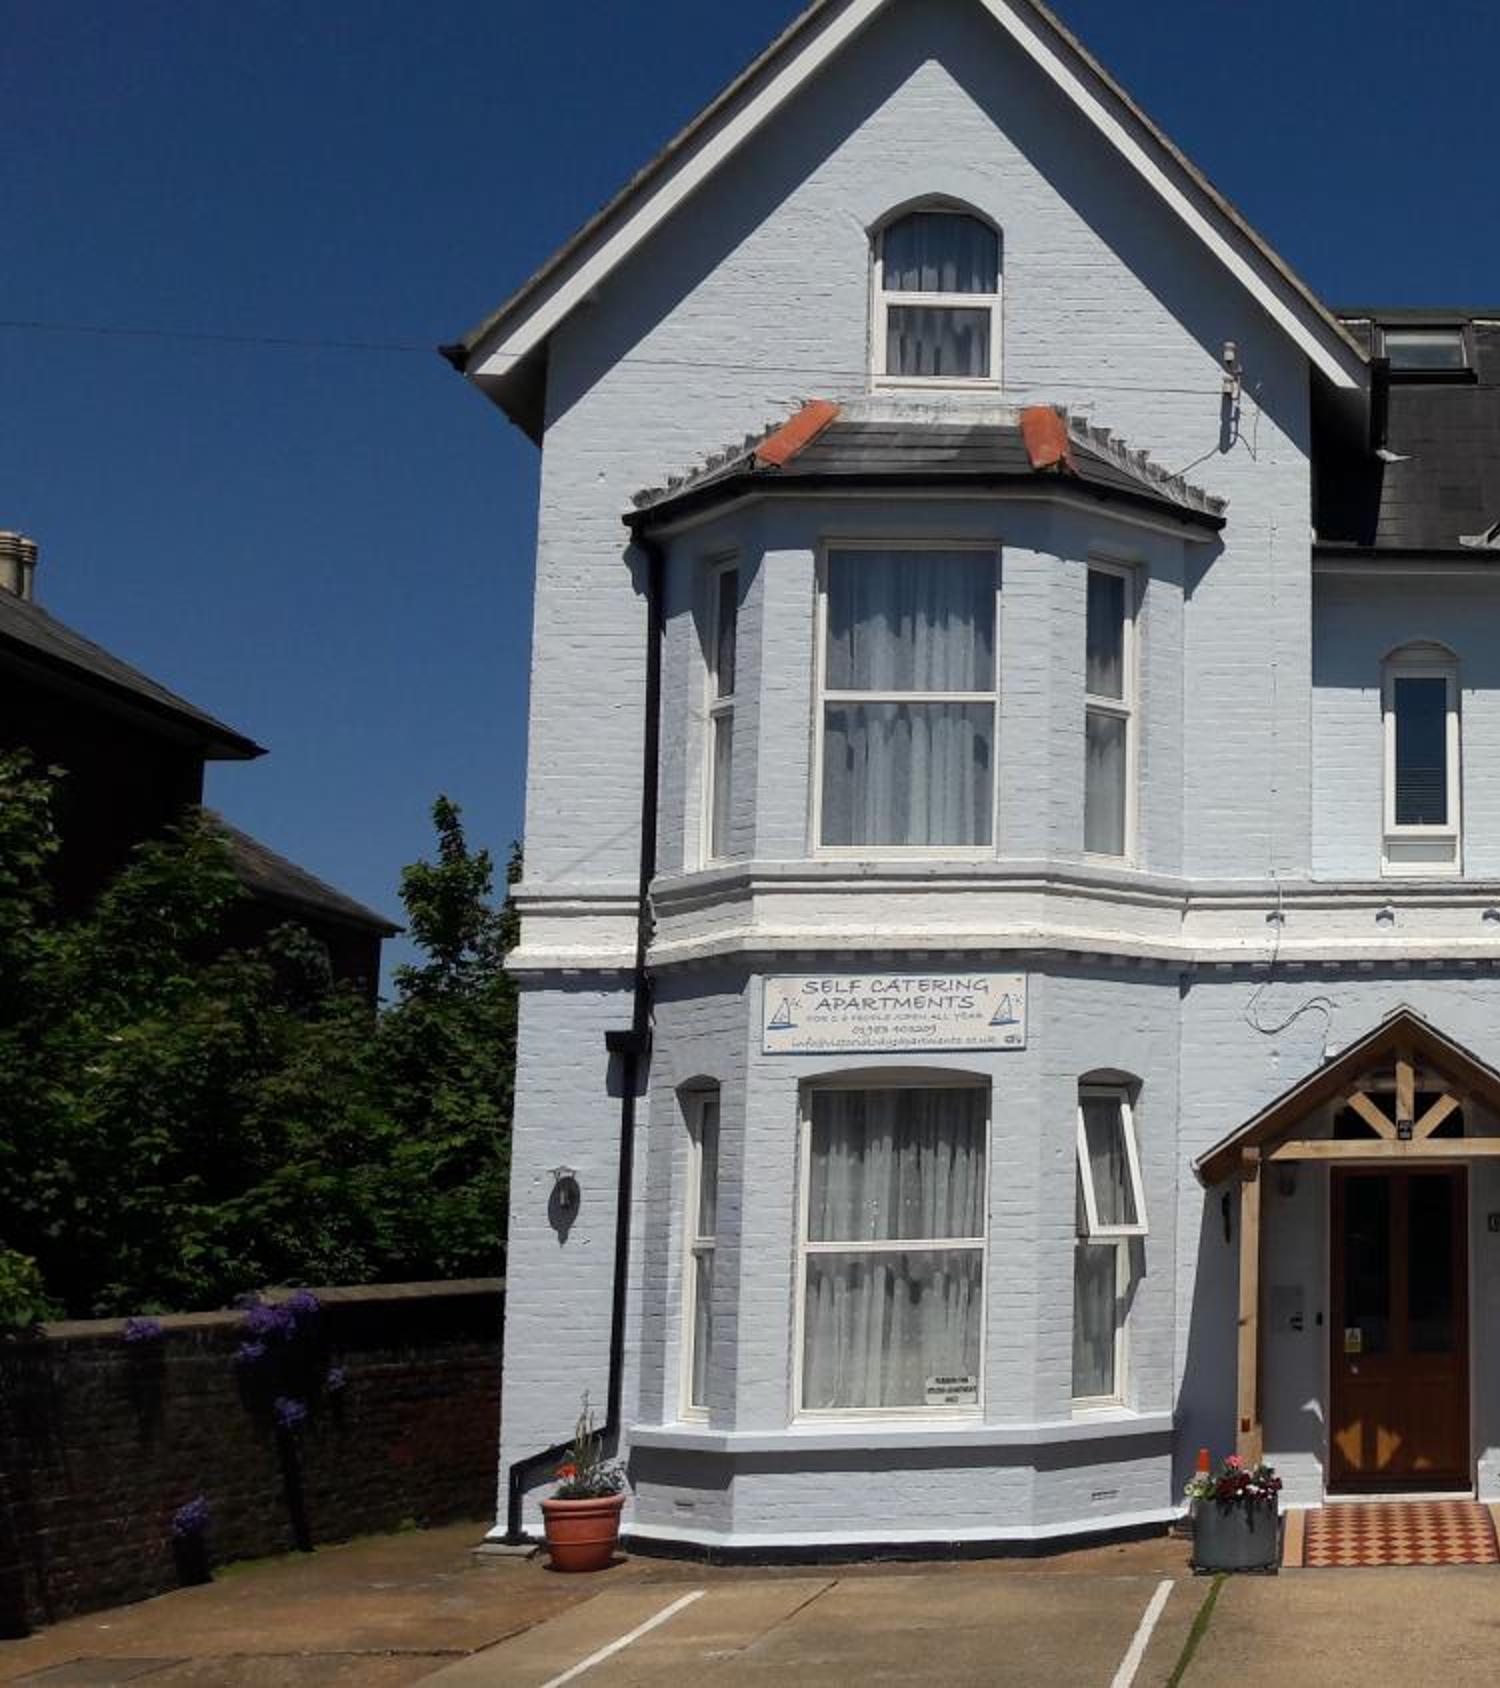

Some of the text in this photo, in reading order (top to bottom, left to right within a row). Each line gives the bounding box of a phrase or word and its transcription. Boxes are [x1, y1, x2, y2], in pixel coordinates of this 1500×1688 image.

[801, 978, 989, 994] SELF CATERING
[815, 995, 976, 1012] APARTMENTS
